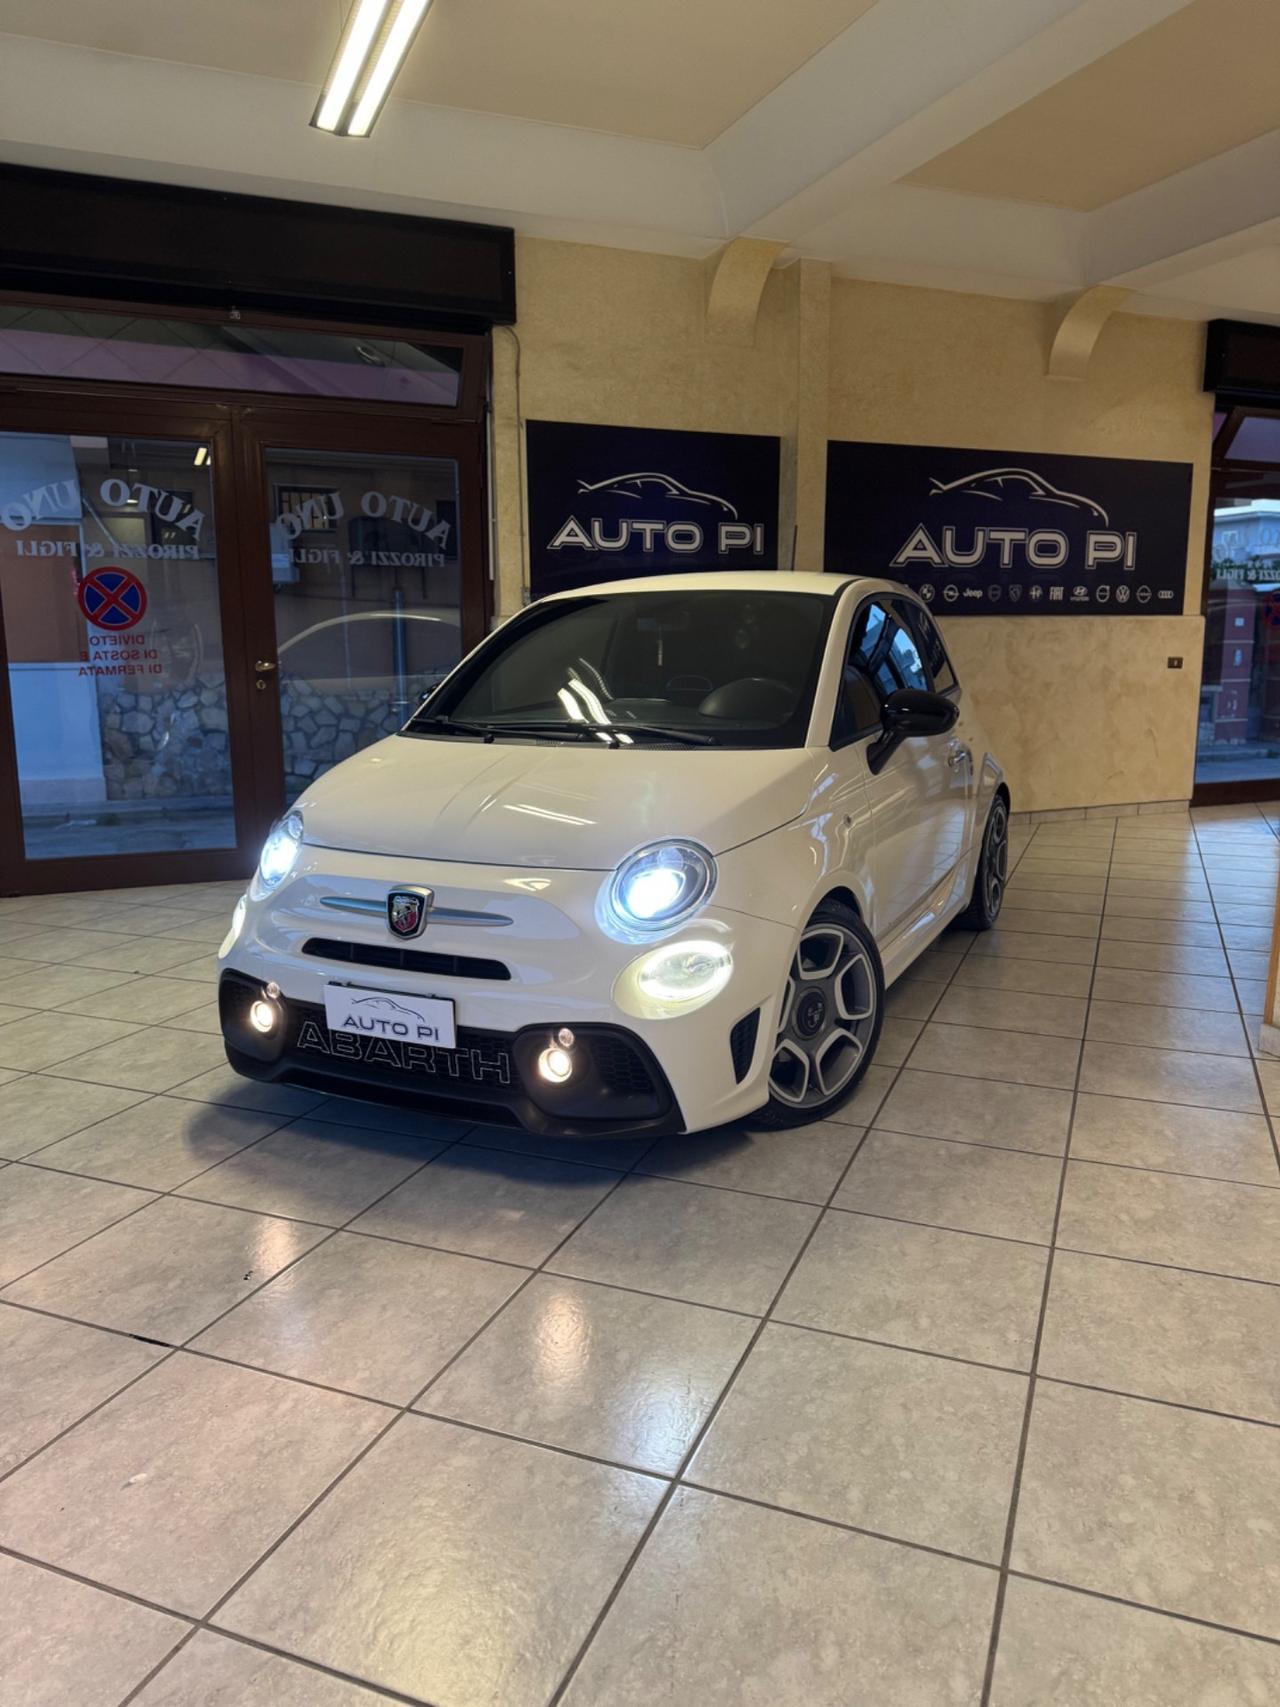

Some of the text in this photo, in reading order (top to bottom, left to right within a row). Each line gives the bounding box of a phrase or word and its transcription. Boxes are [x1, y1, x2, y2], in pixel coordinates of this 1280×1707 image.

[546, 514, 764, 555] AUTO PI
[889, 522, 1137, 571] AUTO PI
[963, 588, 983, 599] Jeep
[343, 1015, 440, 1041] AUTO PI
[297, 1021, 510, 1083] ABARTH
